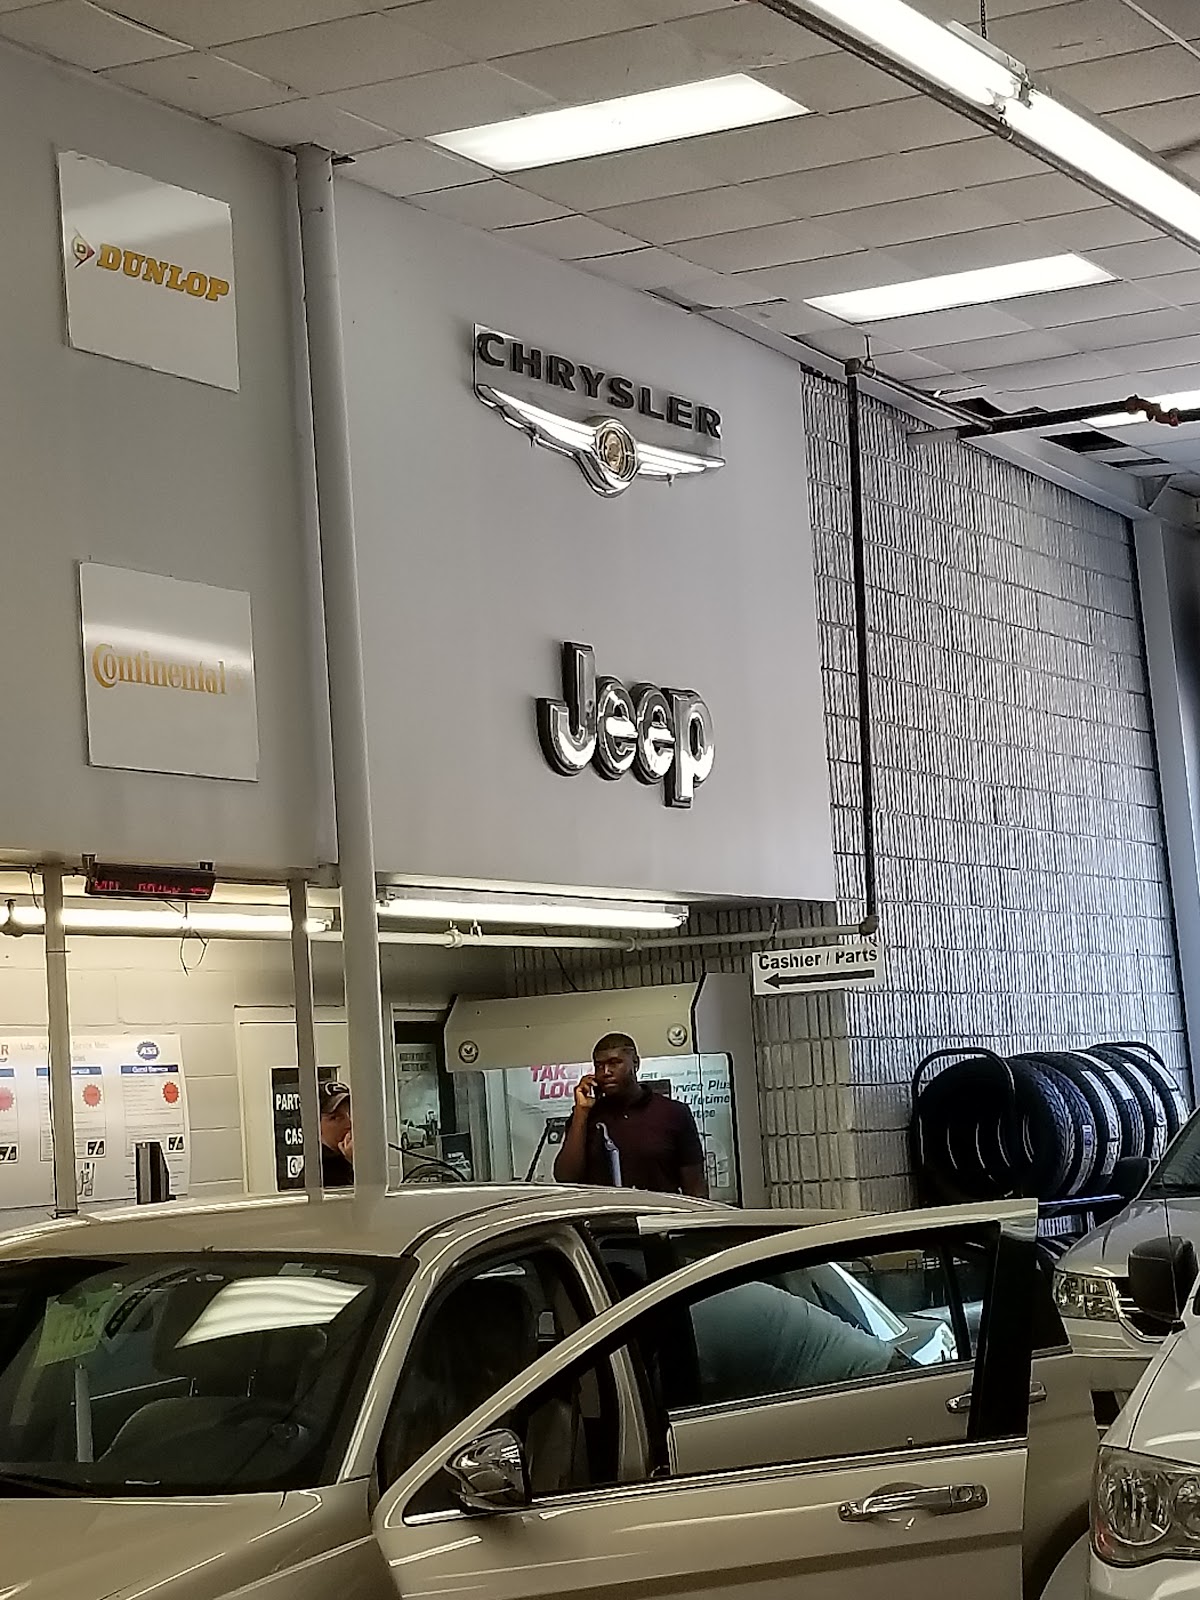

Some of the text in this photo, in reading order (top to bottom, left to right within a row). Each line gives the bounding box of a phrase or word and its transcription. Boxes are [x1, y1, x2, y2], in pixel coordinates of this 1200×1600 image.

[97, 243, 230, 302] DUNLOP
[477, 333, 723, 439] CHRYSLER
[92, 644, 227, 695] Continental
[536, 641, 715, 808] Jeep
[759, 953, 821, 970] Cashier
[836, 949, 877, 964] Parts
[275, 1093, 301, 1111] PART
